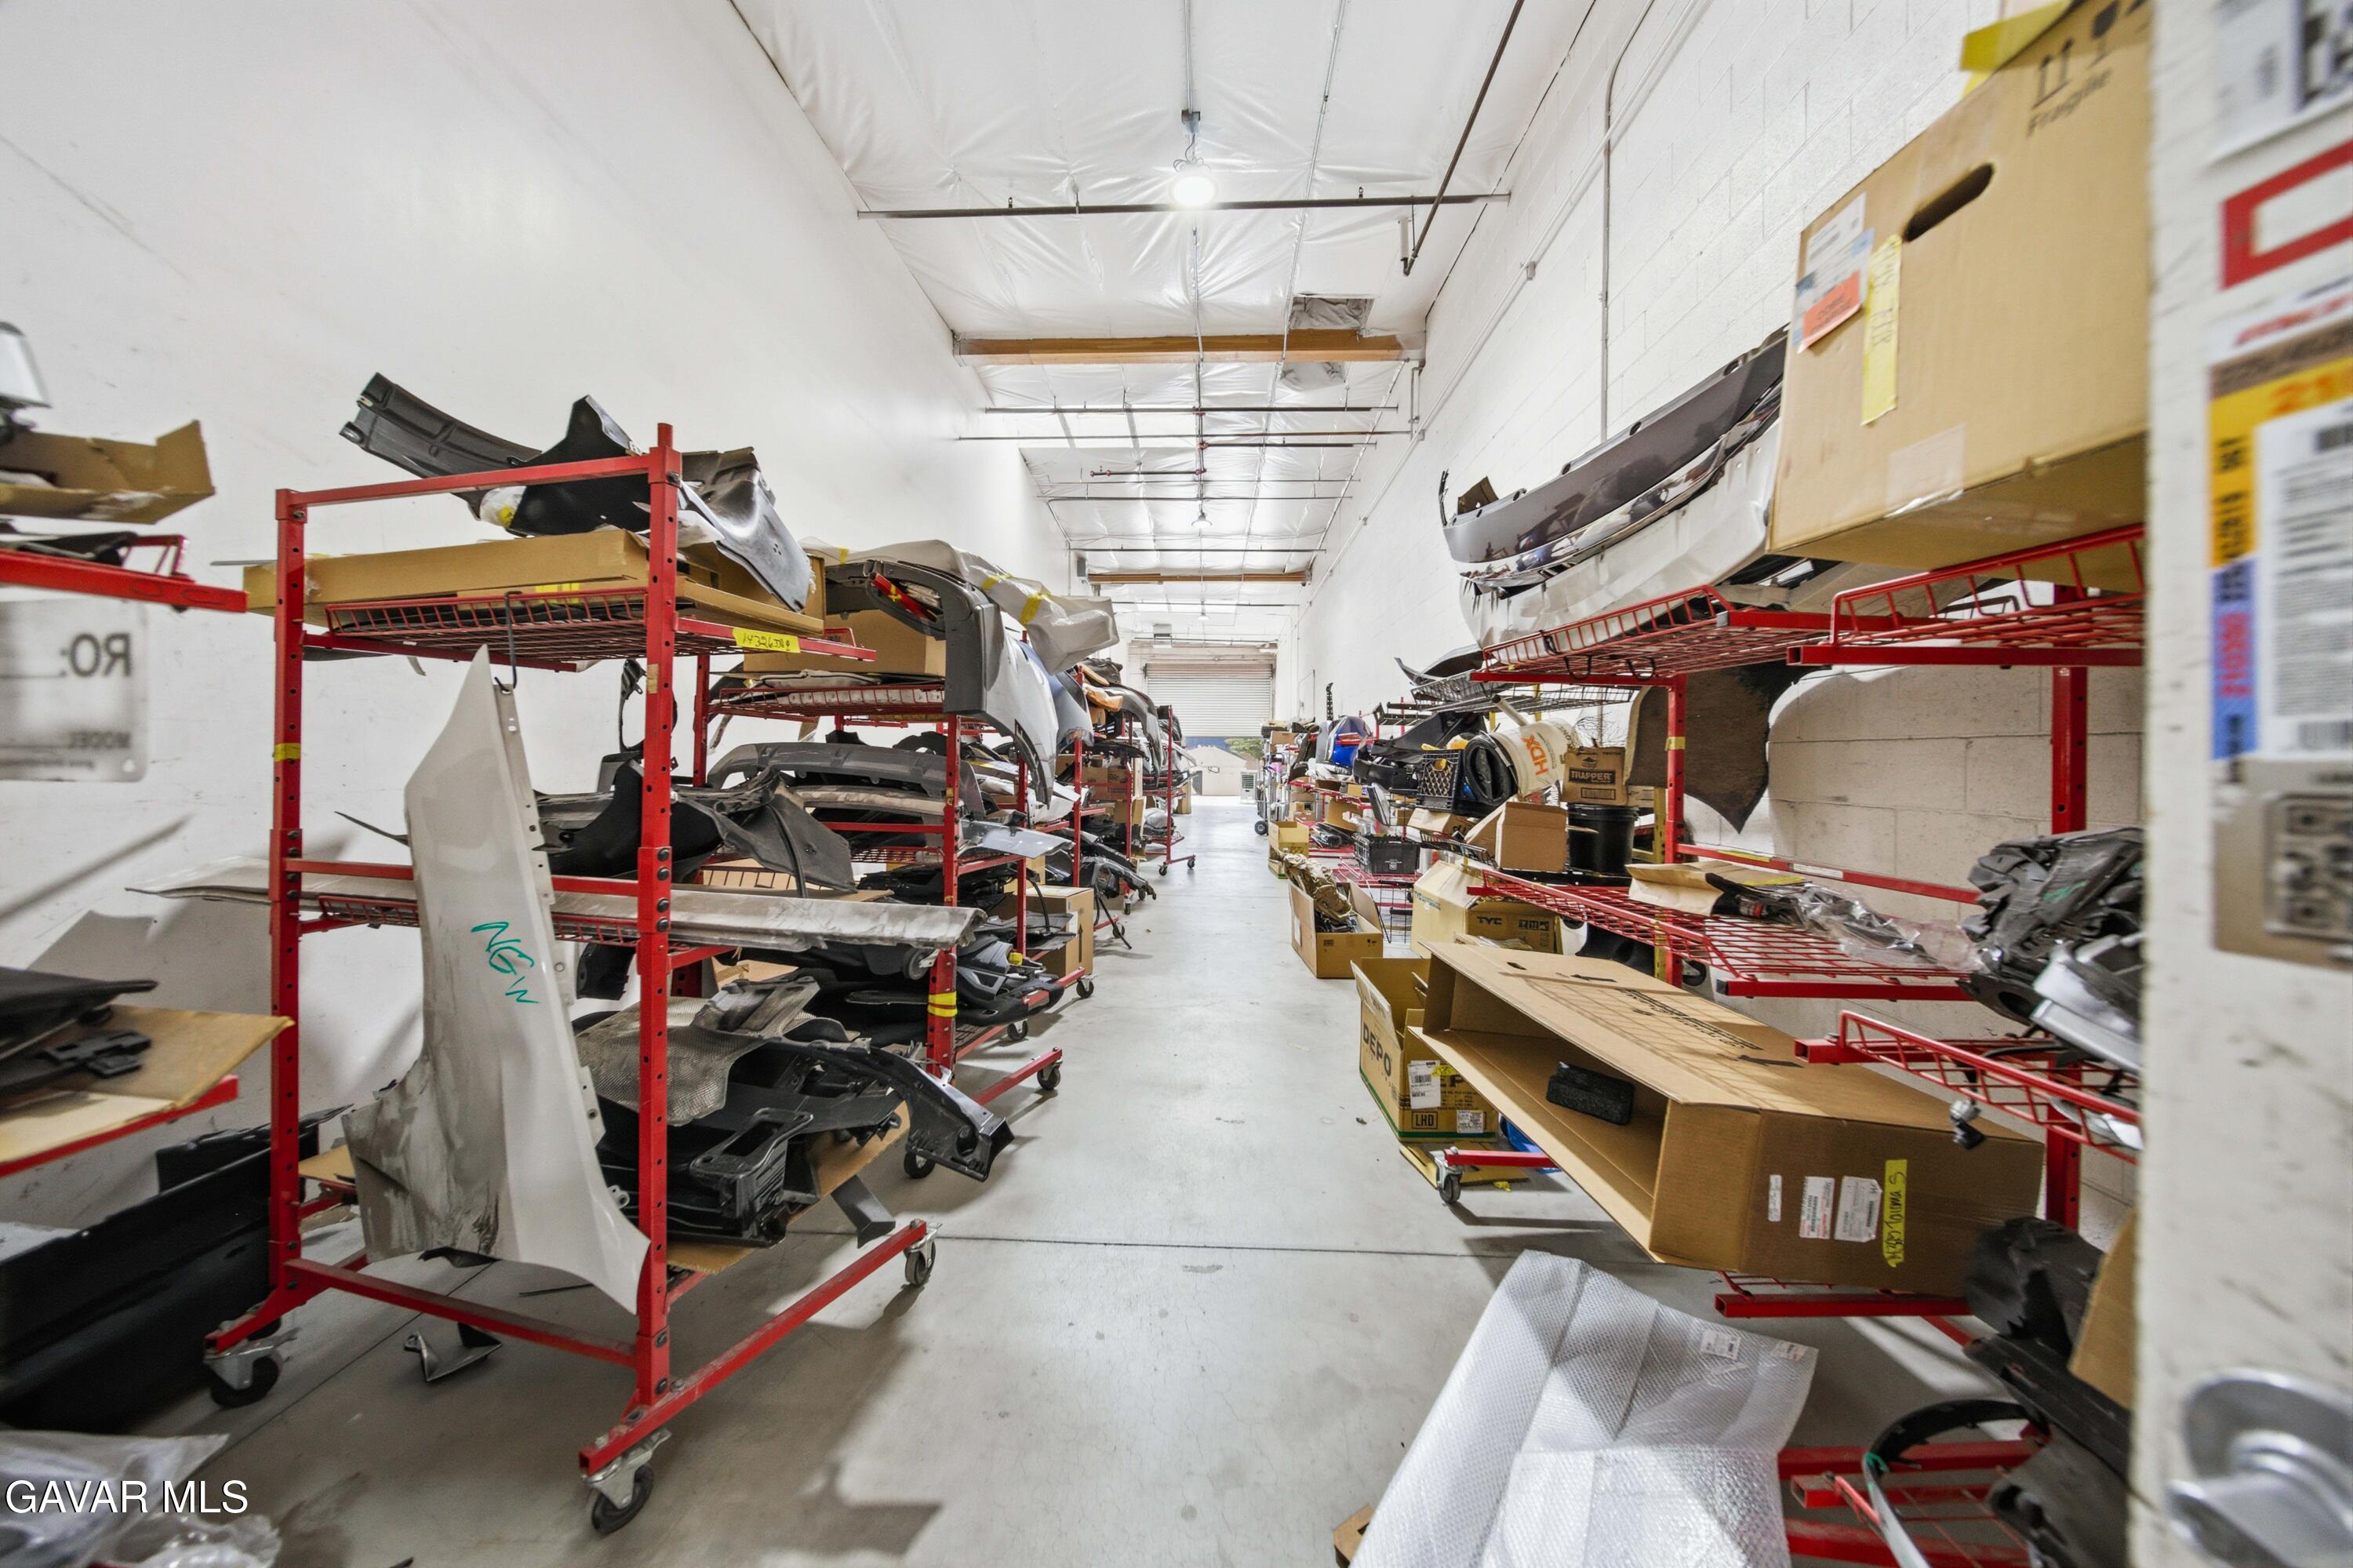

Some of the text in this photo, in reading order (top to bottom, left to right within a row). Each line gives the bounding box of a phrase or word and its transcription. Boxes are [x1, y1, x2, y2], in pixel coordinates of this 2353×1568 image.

[1521, 733, 1549, 776] HDX
[1570, 770, 1613, 780] TRAPPER
[1476, 915, 1502, 926] TYC
[1362, 1021, 1391, 1077] DEPO
[1415, 1114, 1435, 1127] LHD
